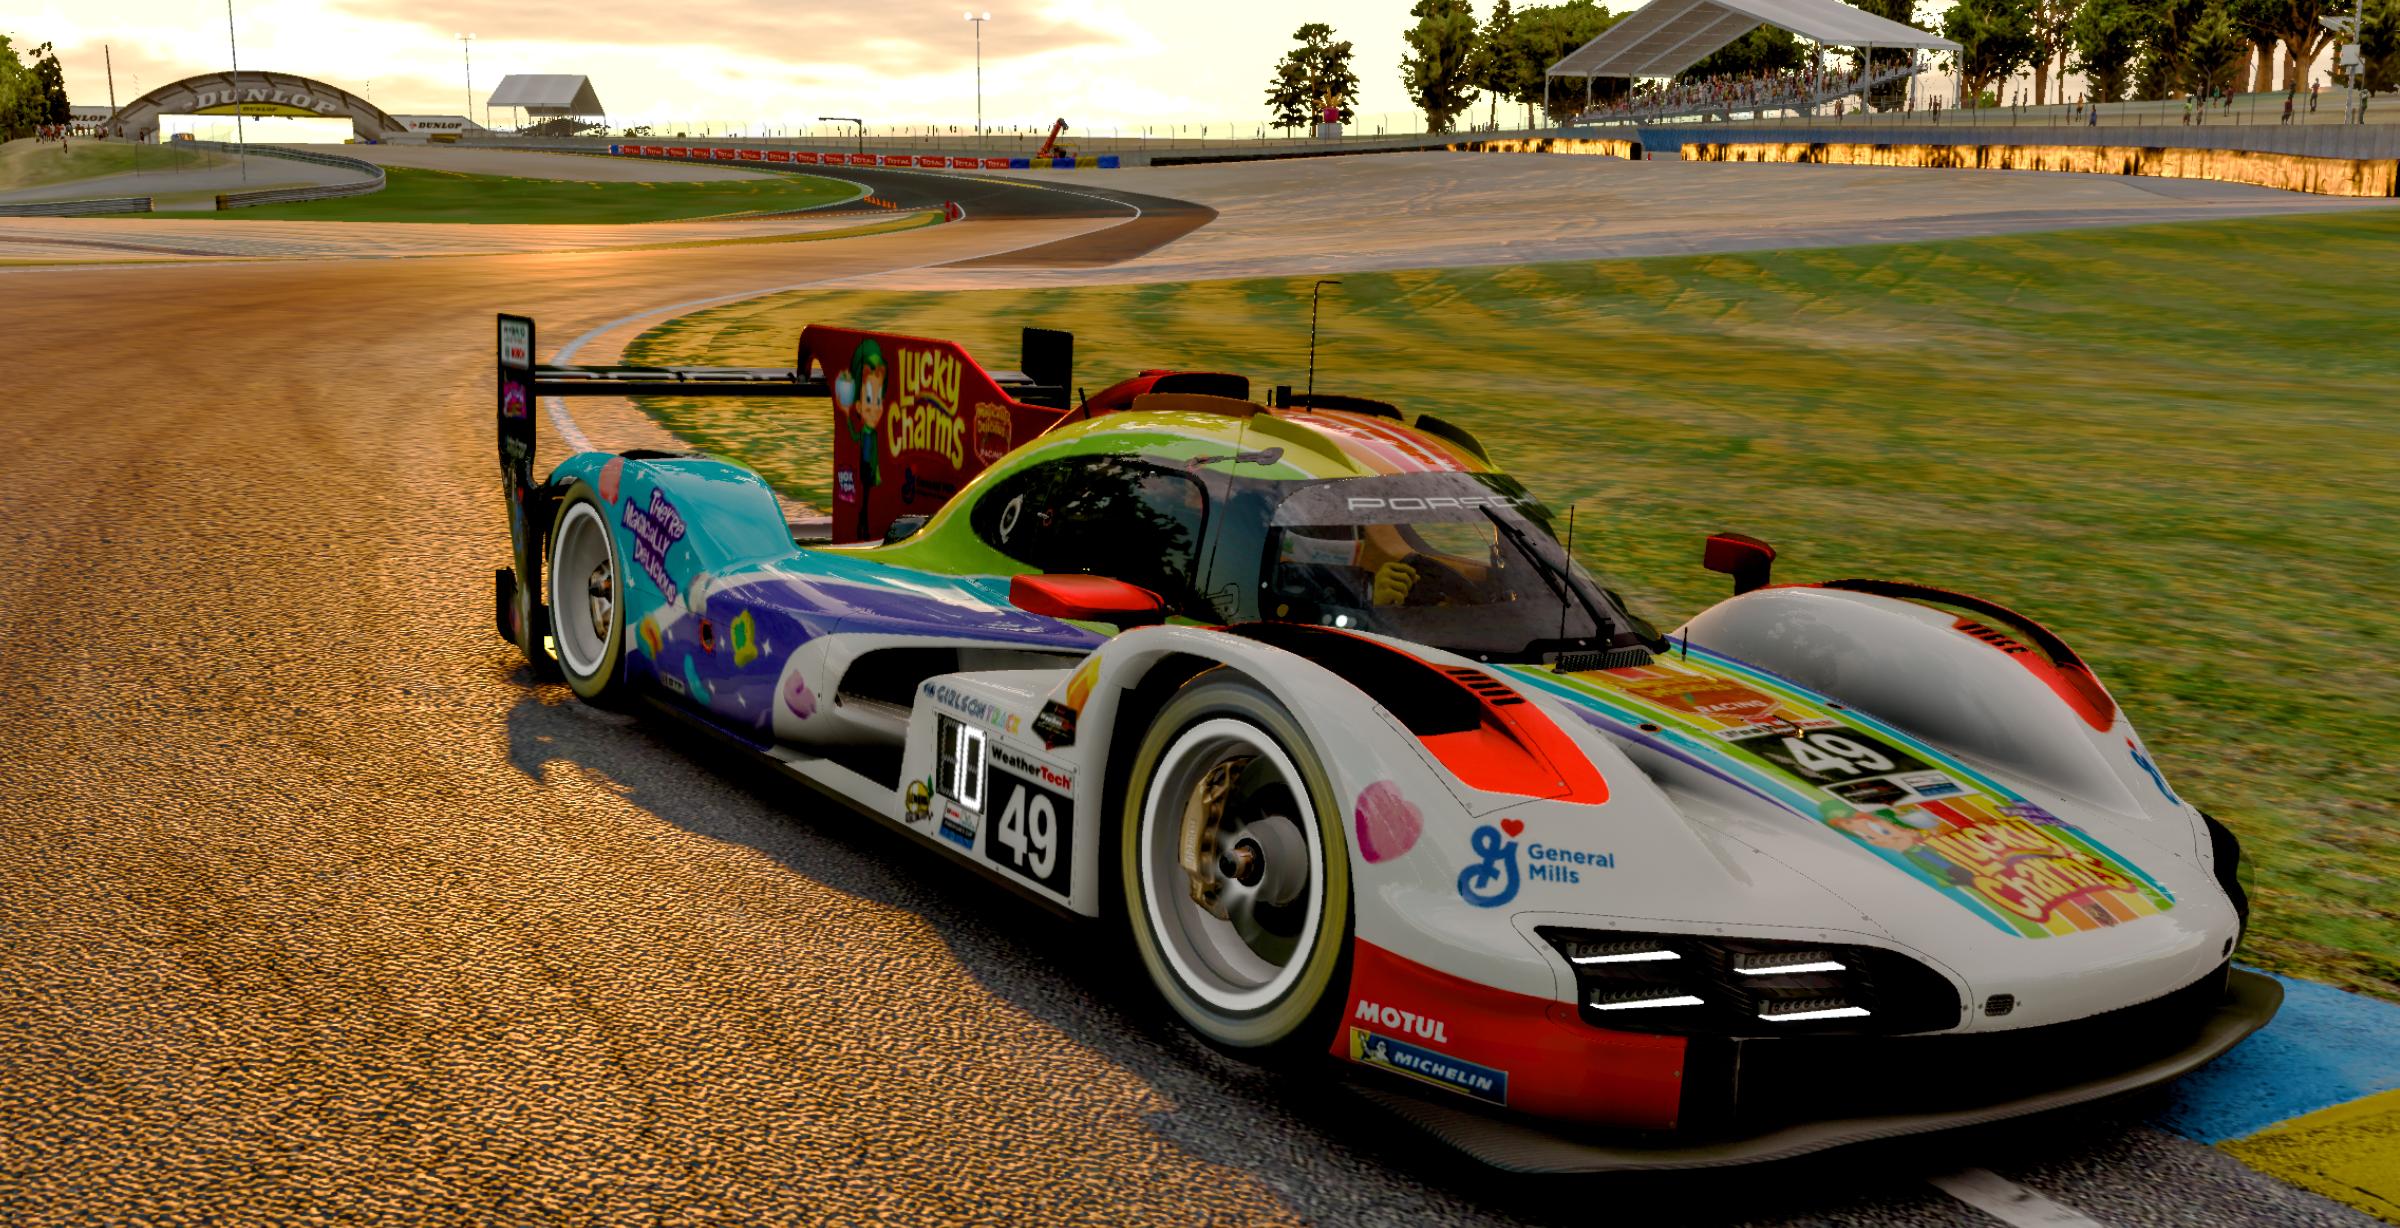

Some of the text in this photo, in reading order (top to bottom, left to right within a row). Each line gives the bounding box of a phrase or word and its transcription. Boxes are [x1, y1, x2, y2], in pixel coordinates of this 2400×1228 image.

[196, 87, 337, 114] DUNLOP
[418, 121, 463, 129] DUNLOP
[898, 347, 962, 417] Lucky
[887, 401, 966, 470] Charms
[1694, 700, 1769, 714] RACING
[991, 744, 1072, 791] WeatherTech
[1781, 732, 1896, 775] 49
[998, 783, 1058, 880] 49
[1922, 817, 2068, 878] Lucky
[1527, 843, 1615, 869] General
[1528, 863, 1580, 884] Mills
[1973, 852, 2136, 920] Charms
[1355, 999, 1448, 1044] MOTUL
[1393, 1050, 1494, 1091] MICHELIN
